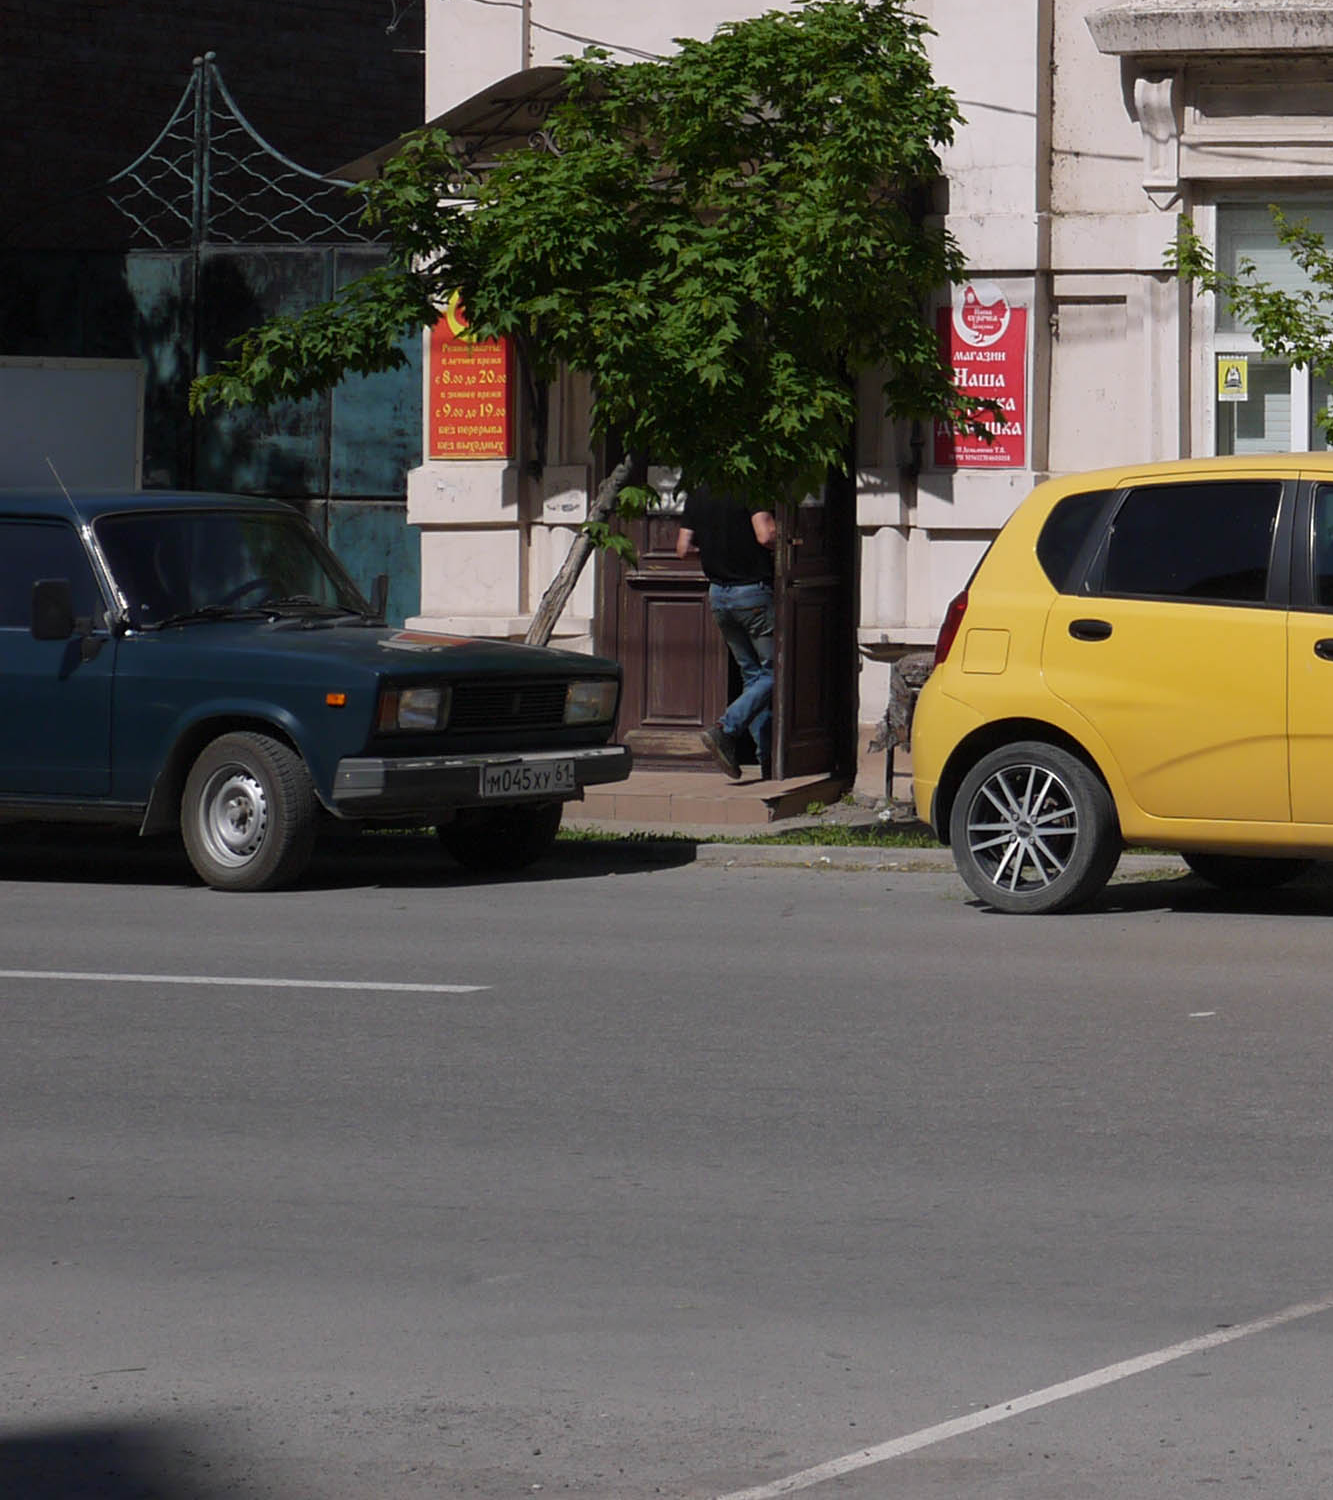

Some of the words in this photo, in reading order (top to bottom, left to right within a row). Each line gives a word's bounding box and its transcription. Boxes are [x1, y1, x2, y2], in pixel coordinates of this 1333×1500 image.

[442, 370, 463, 384] 8.00
[465, 376, 476, 385] до
[479, 370, 506, 384] 20.00
[953, 367, 1005, 387] Наша
[442, 403, 464, 417] 9.00
[465, 409, 477, 418] до
[480, 403, 506, 417] 19.00
[555, 764, 570, 781] 61
